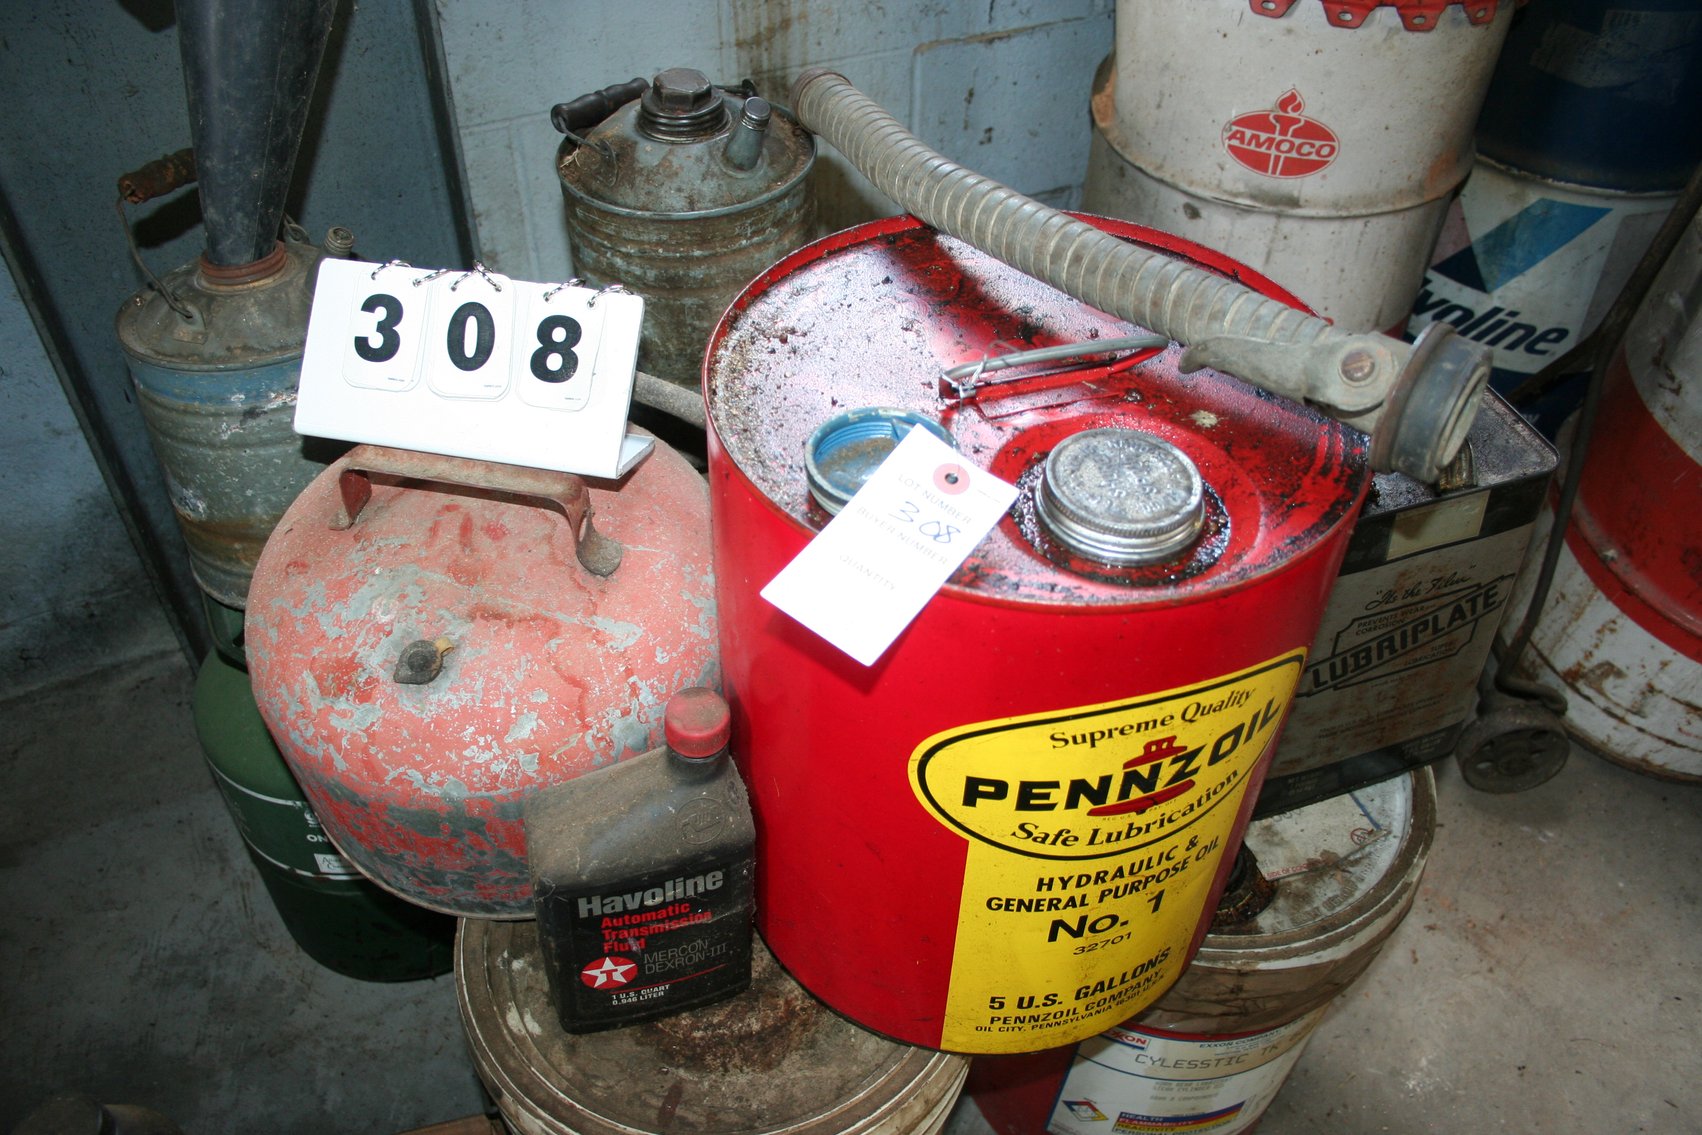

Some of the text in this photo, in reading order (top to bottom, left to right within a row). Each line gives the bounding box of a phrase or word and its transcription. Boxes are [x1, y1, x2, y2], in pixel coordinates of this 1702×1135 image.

[1225, 130, 1336, 159] AMOCO
[354, 293, 582, 384] 308
[1412, 288, 1570, 356] voline
[898, 473, 974, 525] LOT NUMBER
[887, 500, 961, 544] 308
[896, 532, 949, 566] NUMBER
[1312, 583, 1499, 689] LUBRIPLATE
[1050, 687, 1256, 750] Supreme Quality
[961, 696, 1281, 812] PENNZOIL
[1010, 822, 1080, 848] Safe
[1088, 767, 1239, 847] Lubrication
[986, 835, 1220, 913] GENERAL PURPOSE OIL
[1036, 834, 1199, 892] HYDRAULIC &
[577, 869, 725, 919] Havoline
[1146, 889, 1166, 914] 1
[601, 903, 691, 929] Automatic
[601, 911, 713, 941] Transmission
[603, 938, 647, 954] Fluid
[643, 939, 710, 964] MERCON
[644, 943, 728, 976] DEXRON-III
[1072, 931, 1132, 956] 32701
[619, 991, 638, 999] U.S.
[641, 984, 671, 996] QUART
[989, 947, 1172, 1010] 5 U.S. GALLONS
[612, 991, 665, 1006] 0.946 LITER
[989, 967, 1164, 1025] PENNZOIL COMPANY
[975, 1025, 994, 1033] OIL
[1031, 1006, 1113, 1031] PENNSYLVANIA
[1199, 1040, 1234, 1049] EXXON
[1135, 1053, 1249, 1070] CYLESSTIC
[1117, 1123, 1176, 1132] REACTIVITY
[1121, 1113, 1164, 1122] HEALTH
